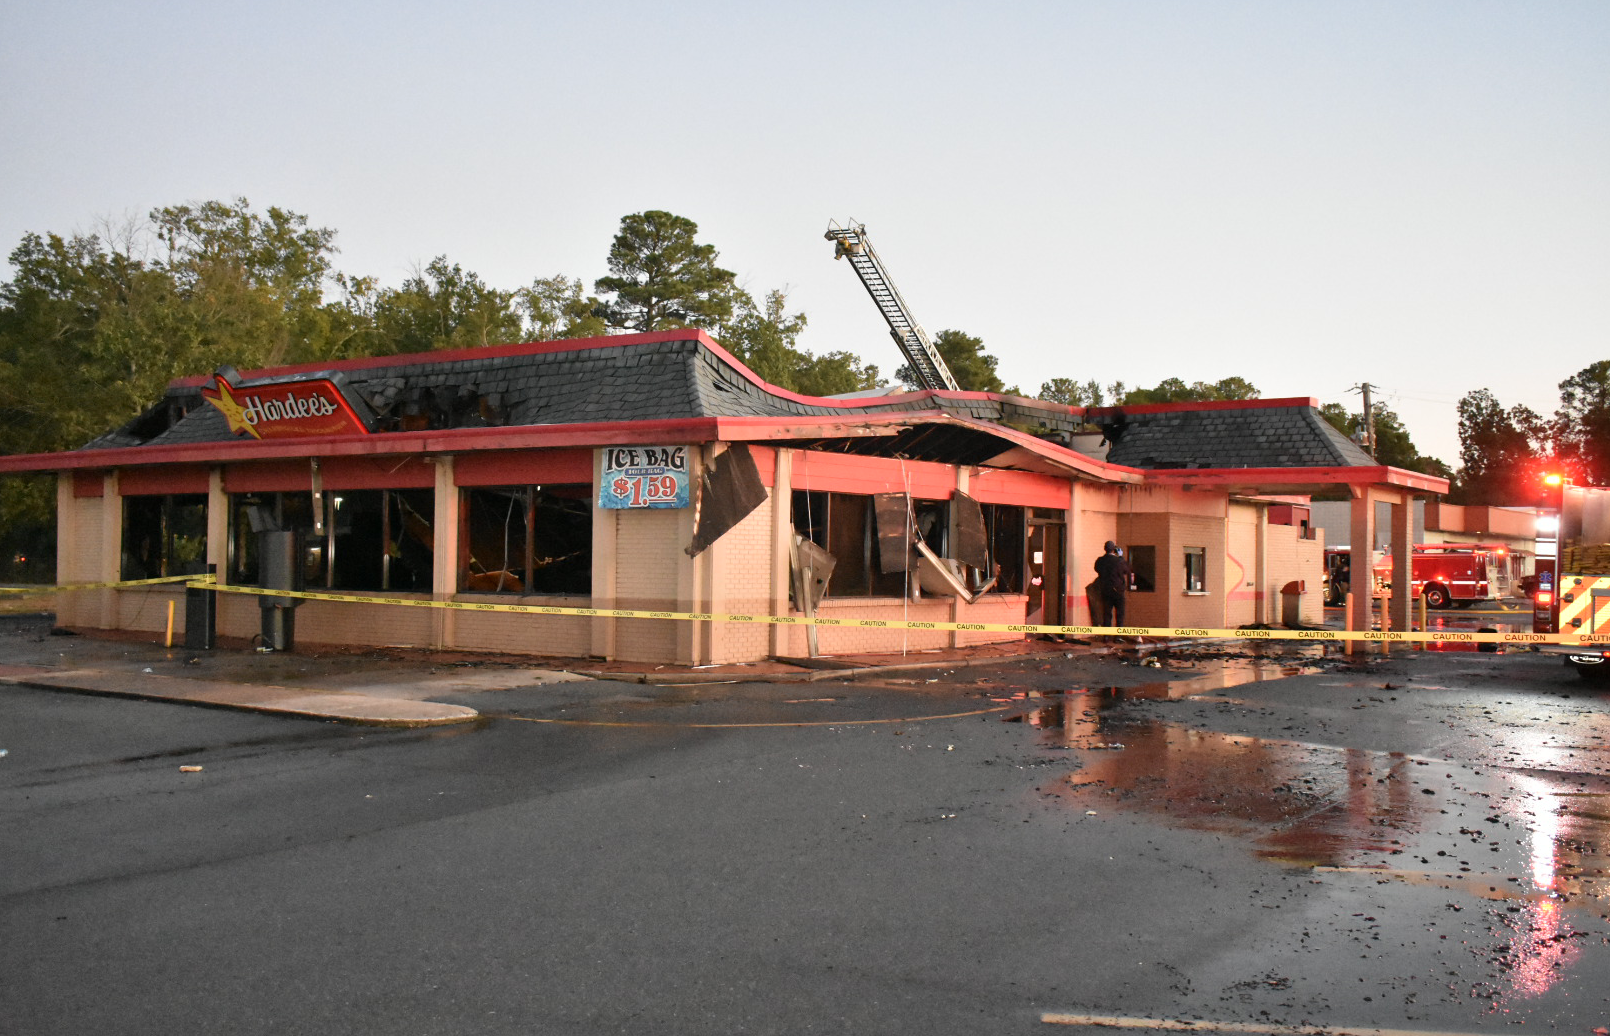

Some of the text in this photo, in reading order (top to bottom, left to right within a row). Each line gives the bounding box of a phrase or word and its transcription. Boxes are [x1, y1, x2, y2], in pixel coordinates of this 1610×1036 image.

[243, 393, 338, 424] Hardee's
[606, 446, 685, 471] ICE BAG
[612, 475, 677, 506] $1.59
